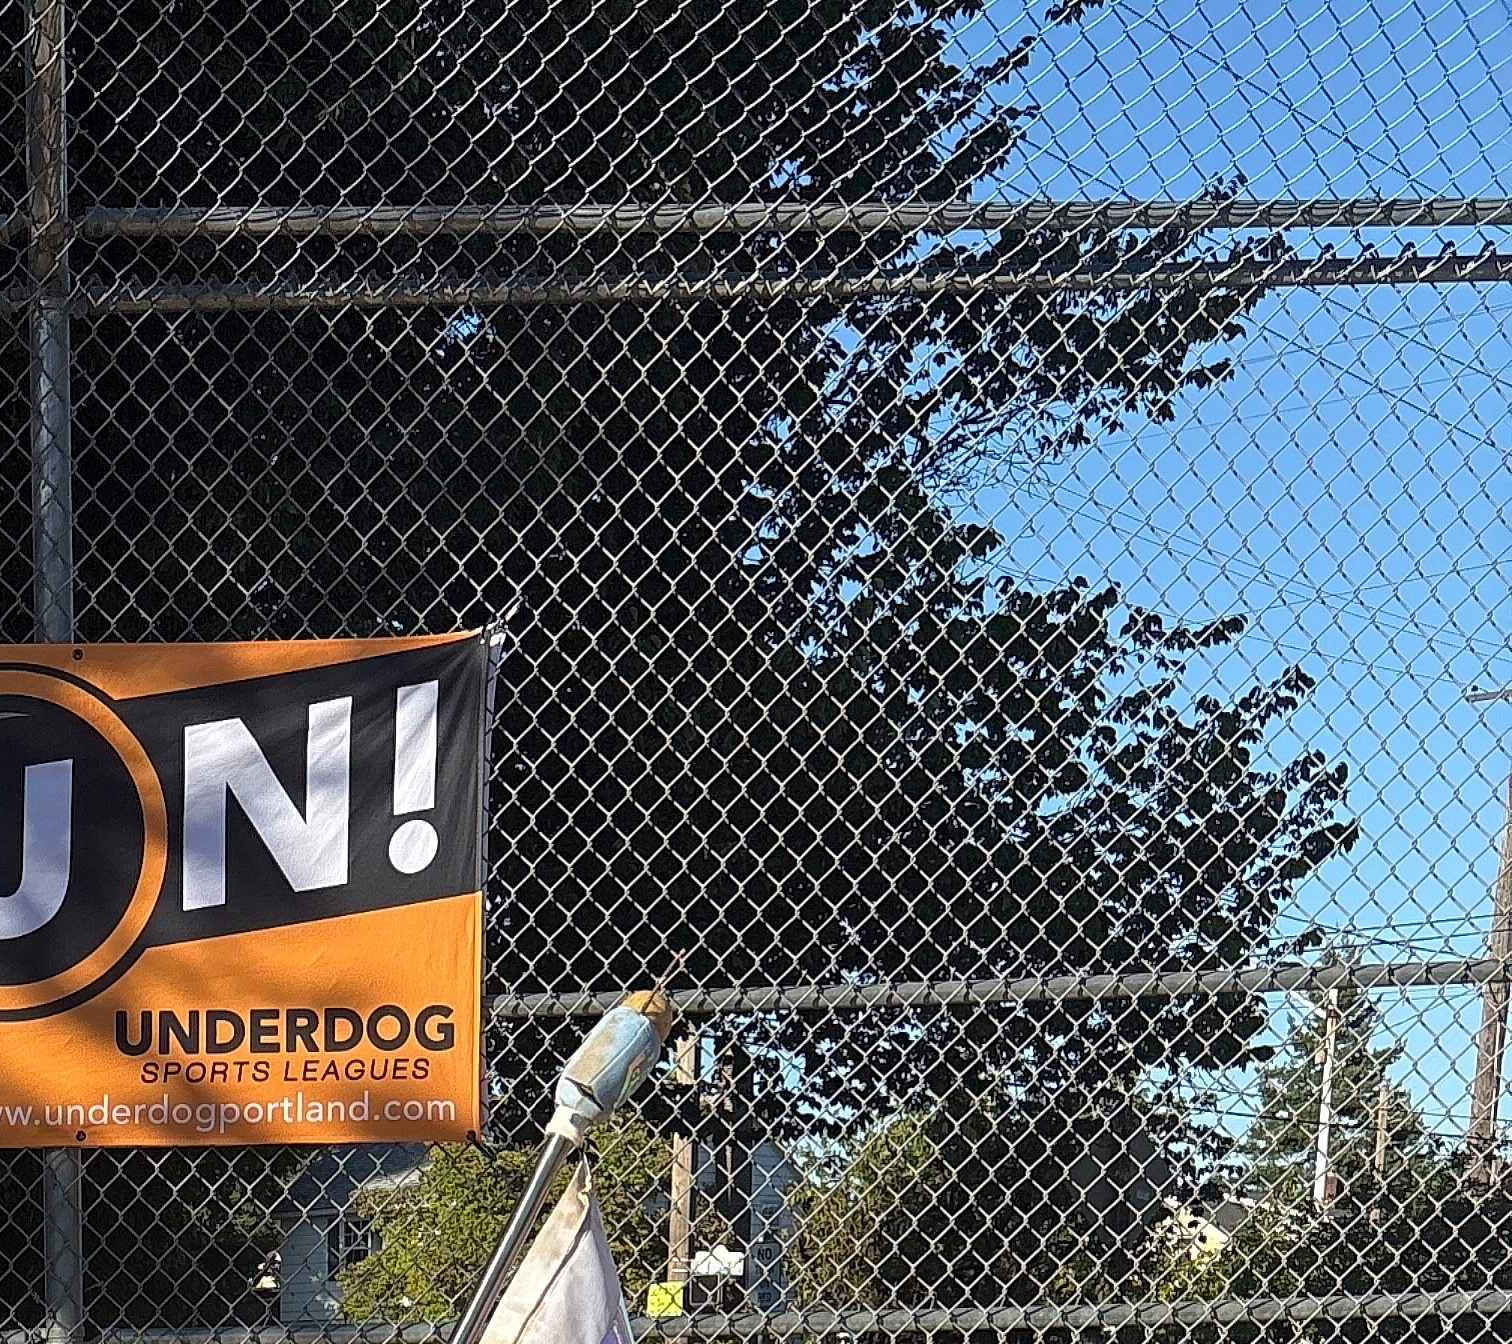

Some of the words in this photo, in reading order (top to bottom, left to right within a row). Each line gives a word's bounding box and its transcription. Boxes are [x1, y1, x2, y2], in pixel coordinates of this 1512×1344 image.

[115, 1004, 455, 1056] UNDERDOG
[140, 1060, 272, 1084] SPORTS
[283, 1058, 431, 1082] LEAGUES
[758, 1248, 772, 1261] NO
